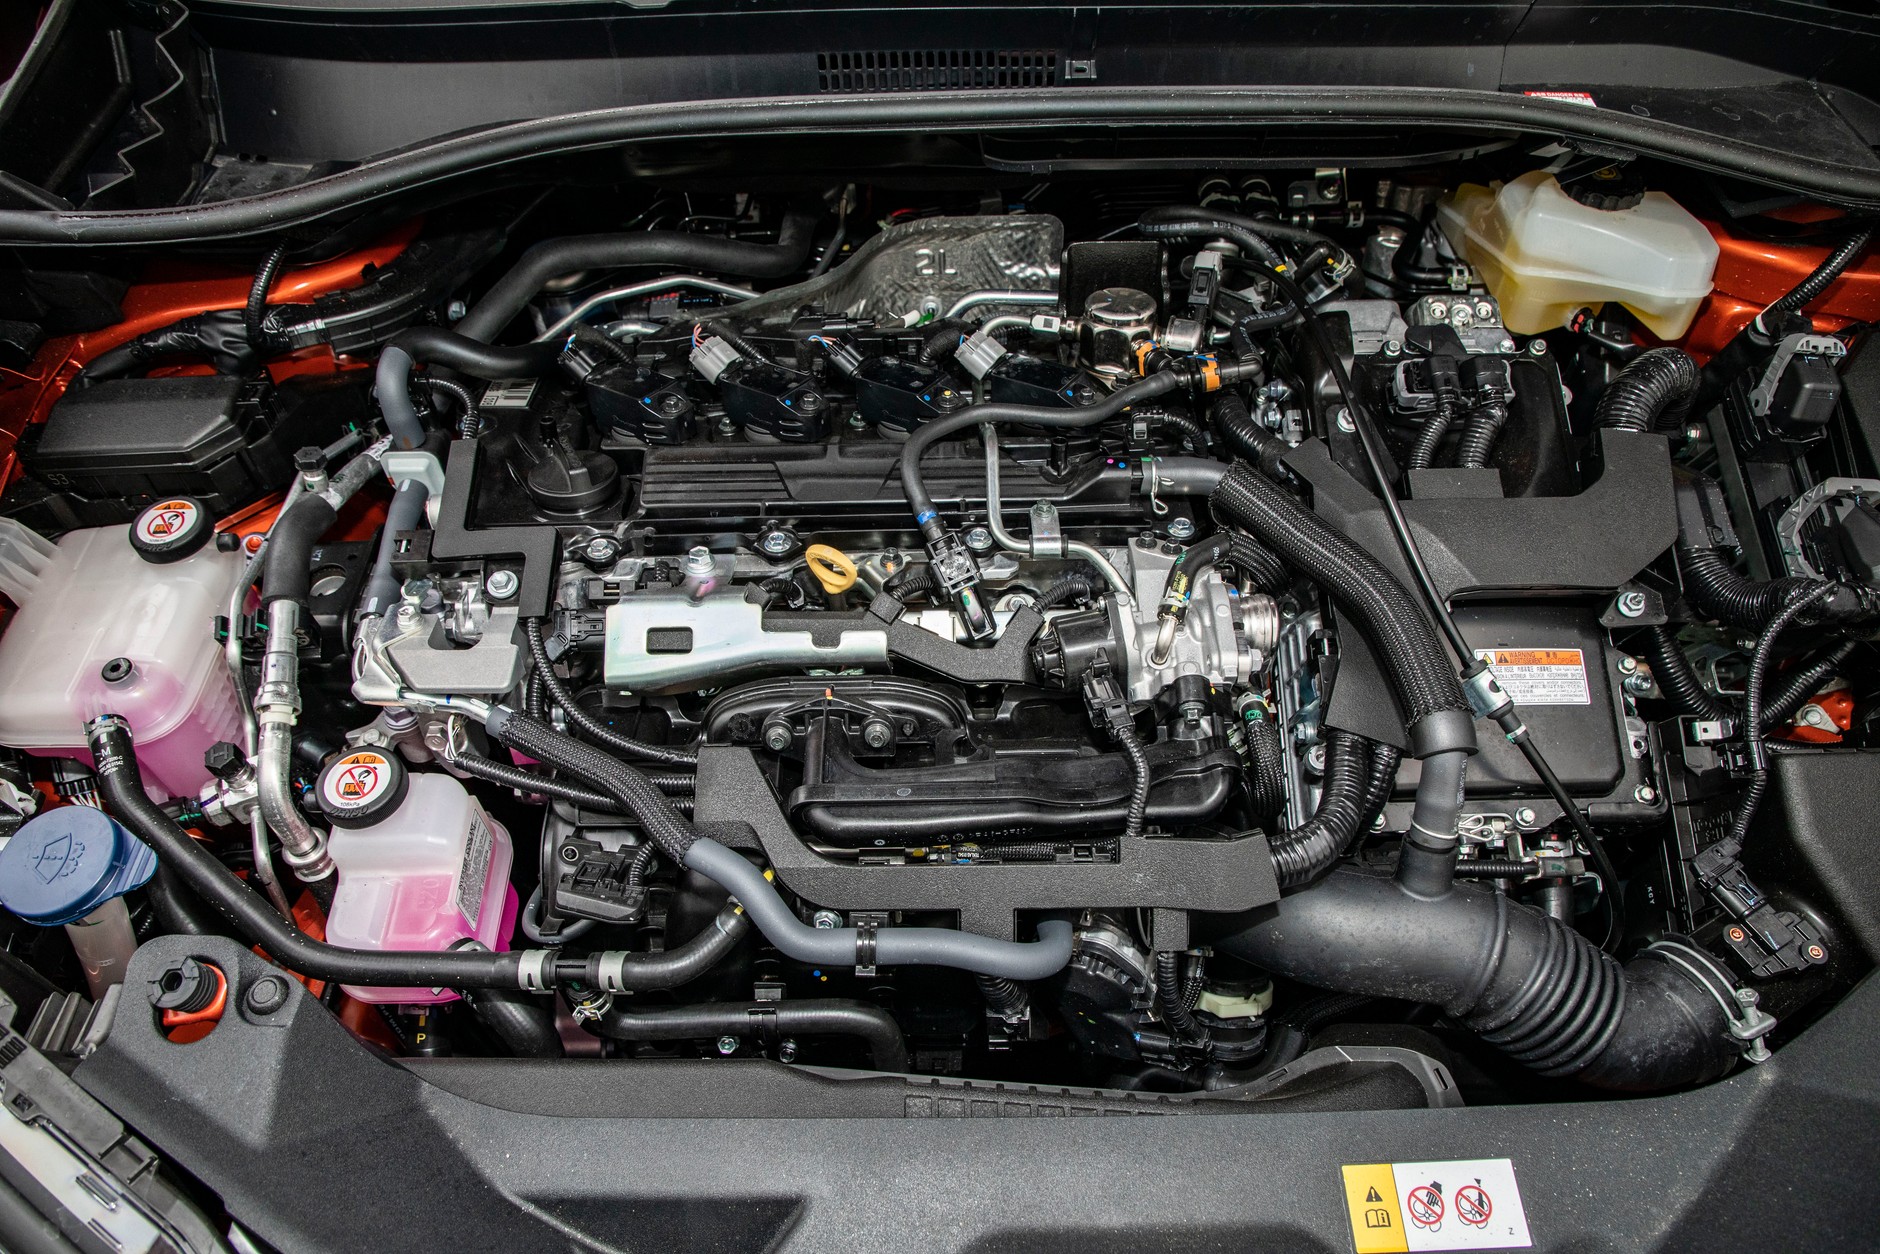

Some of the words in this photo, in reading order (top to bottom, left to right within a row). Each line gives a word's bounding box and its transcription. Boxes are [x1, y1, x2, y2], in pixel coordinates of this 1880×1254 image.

[914, 248, 957, 276] 2L
[329, 805, 370, 818] DENSO
[416, 1033, 426, 1044] P
[1508, 1228, 1514, 1236] Z
